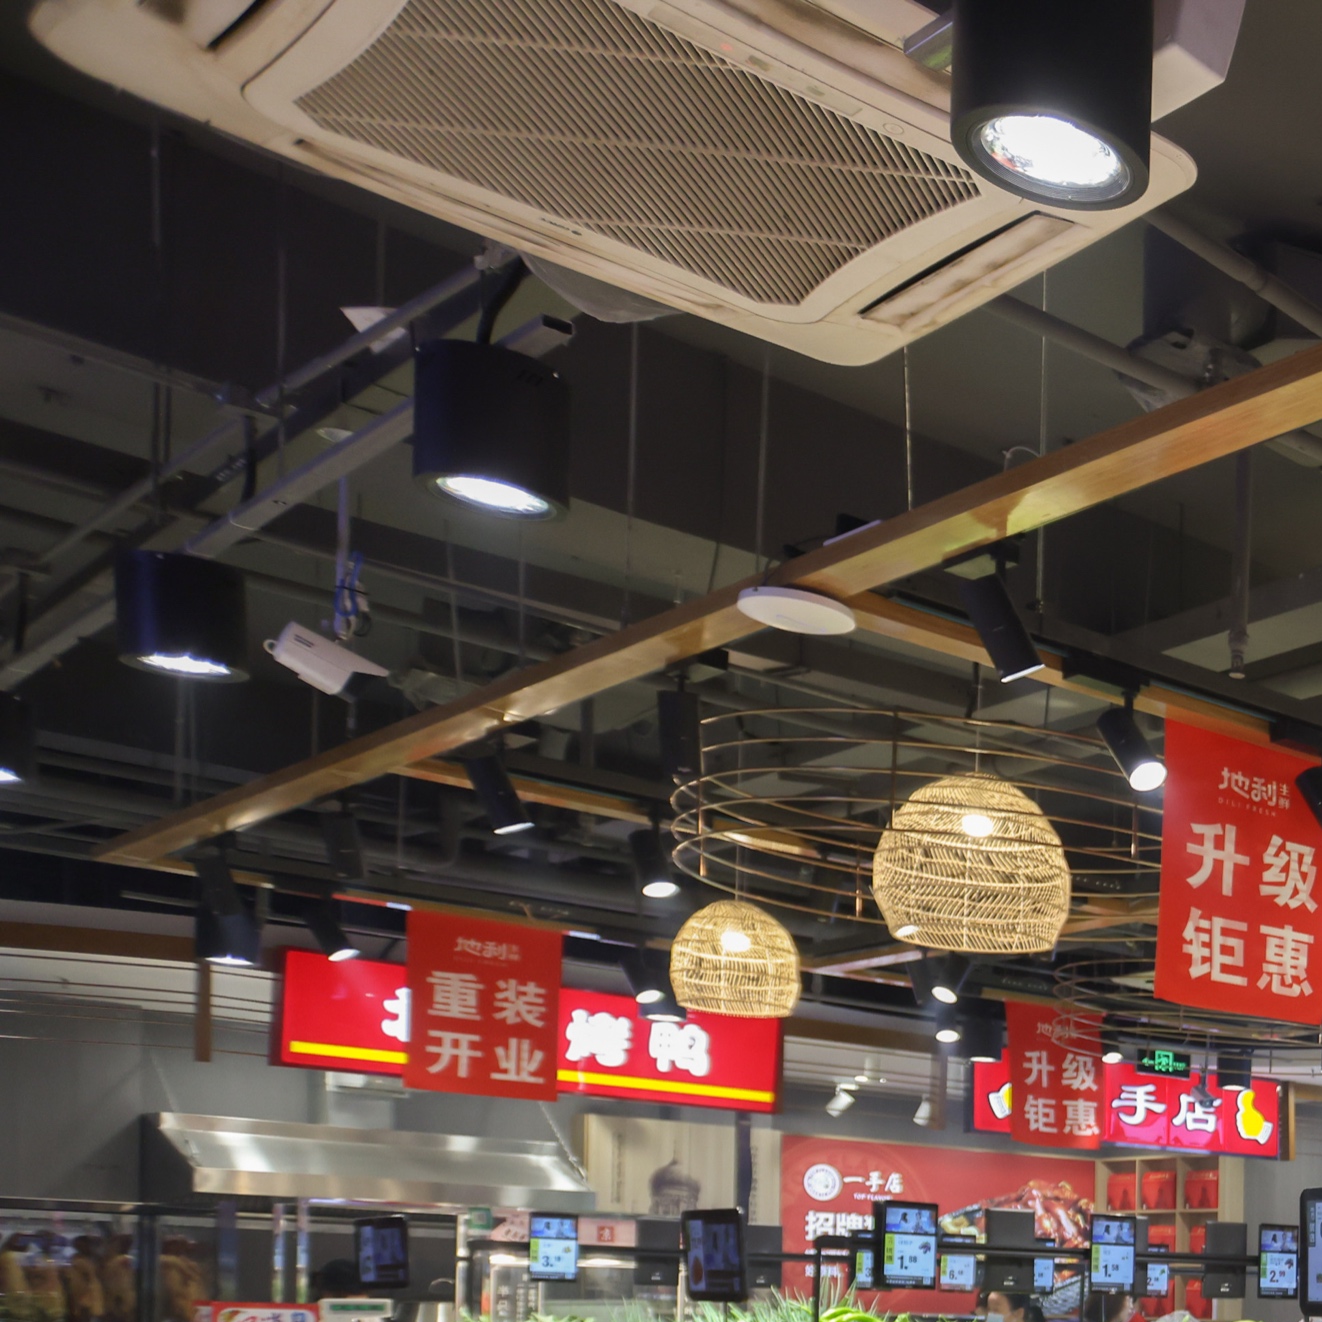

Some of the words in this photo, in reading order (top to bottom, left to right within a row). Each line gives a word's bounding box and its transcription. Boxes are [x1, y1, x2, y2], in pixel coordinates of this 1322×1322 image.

[1186, 822, 1318, 914] 升级
[1182, 906, 1315, 997] 钜惠
[426, 971, 548, 1028] 重装
[425, 1029, 546, 1085] 开业
[565, 1008, 711, 1077] 烤鸭
[1022, 1051, 1098, 1092] 升级
[1024, 1094, 1101, 1137] 钜惠
[1111, 1084, 1223, 1133] 手店
[843, 1171, 904, 1193] 一手店
